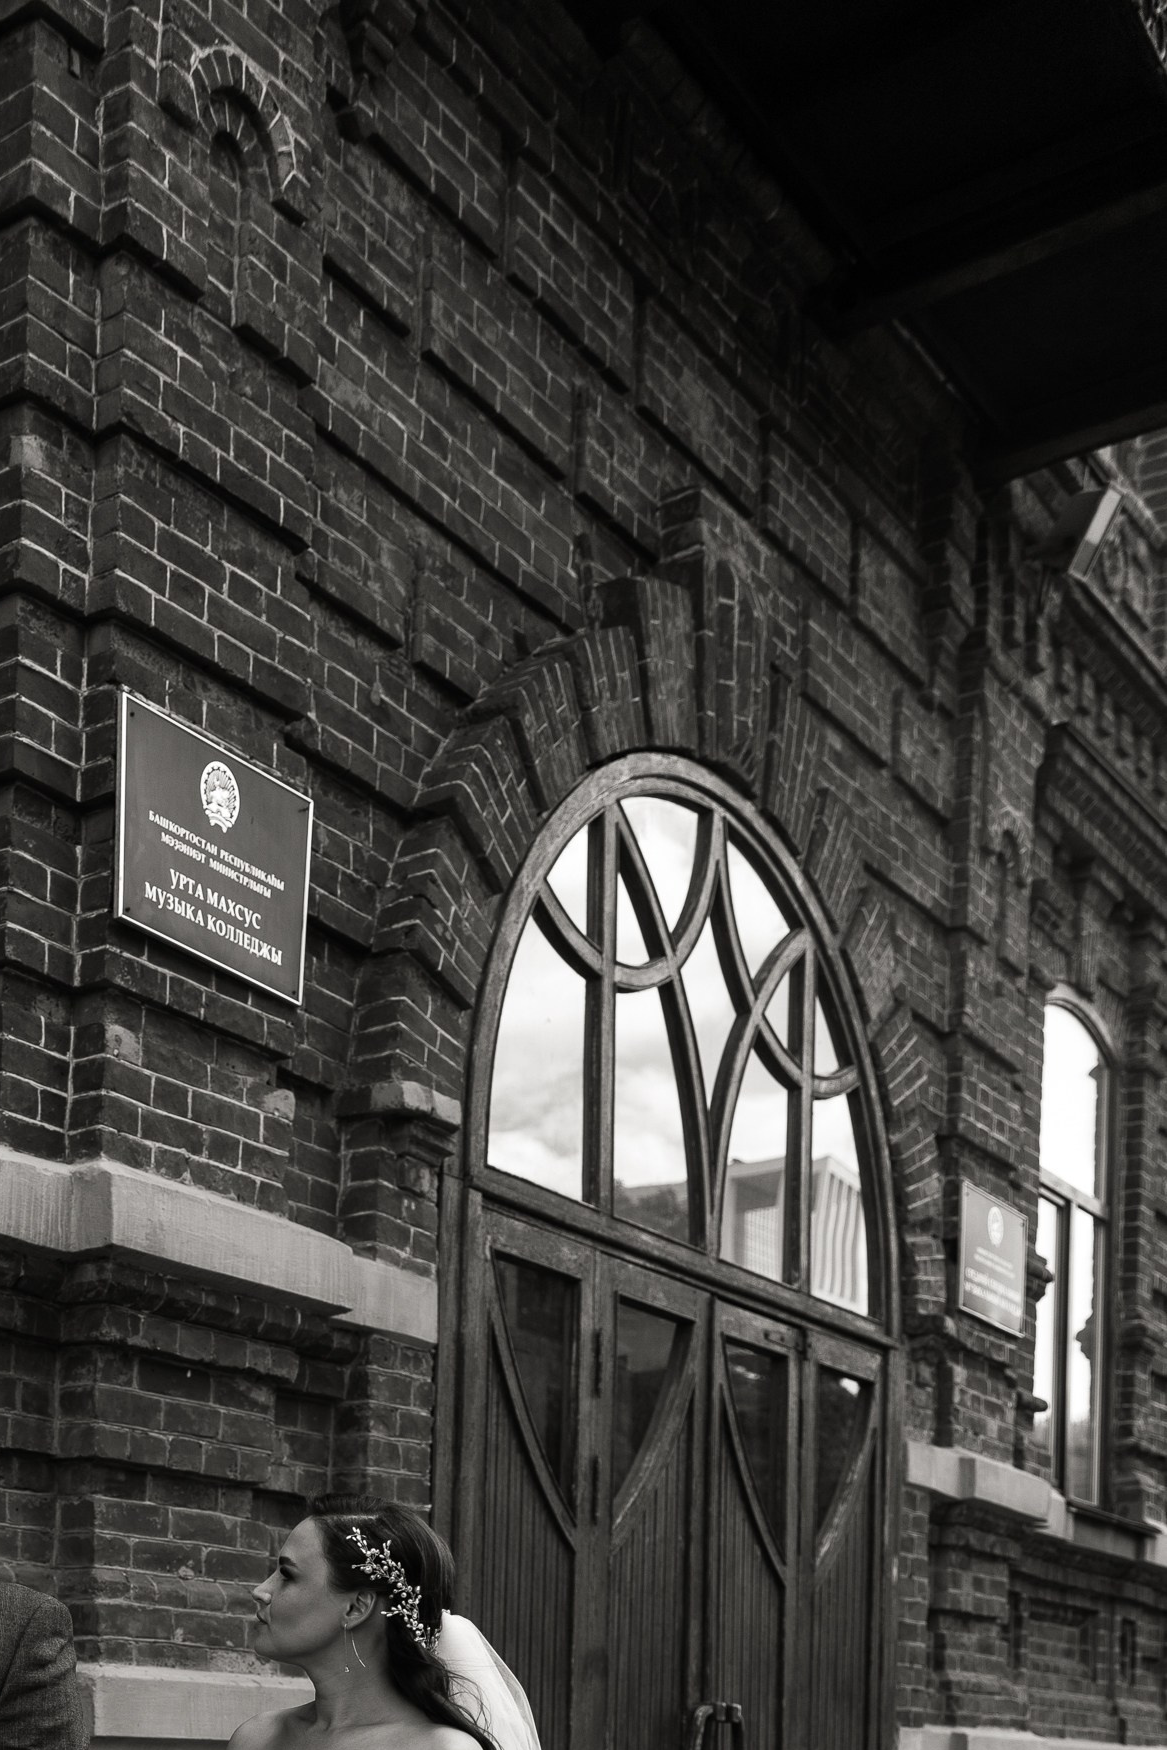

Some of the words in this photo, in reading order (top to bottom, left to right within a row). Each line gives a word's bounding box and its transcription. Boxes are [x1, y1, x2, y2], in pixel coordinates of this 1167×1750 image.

[145, 881, 205, 927] МУЗЫКА
[207, 914, 282, 966] КОЛЛЕДЖЫ
[170, 868, 204, 900] УРТА
[207, 888, 261, 929] МАХСУС
